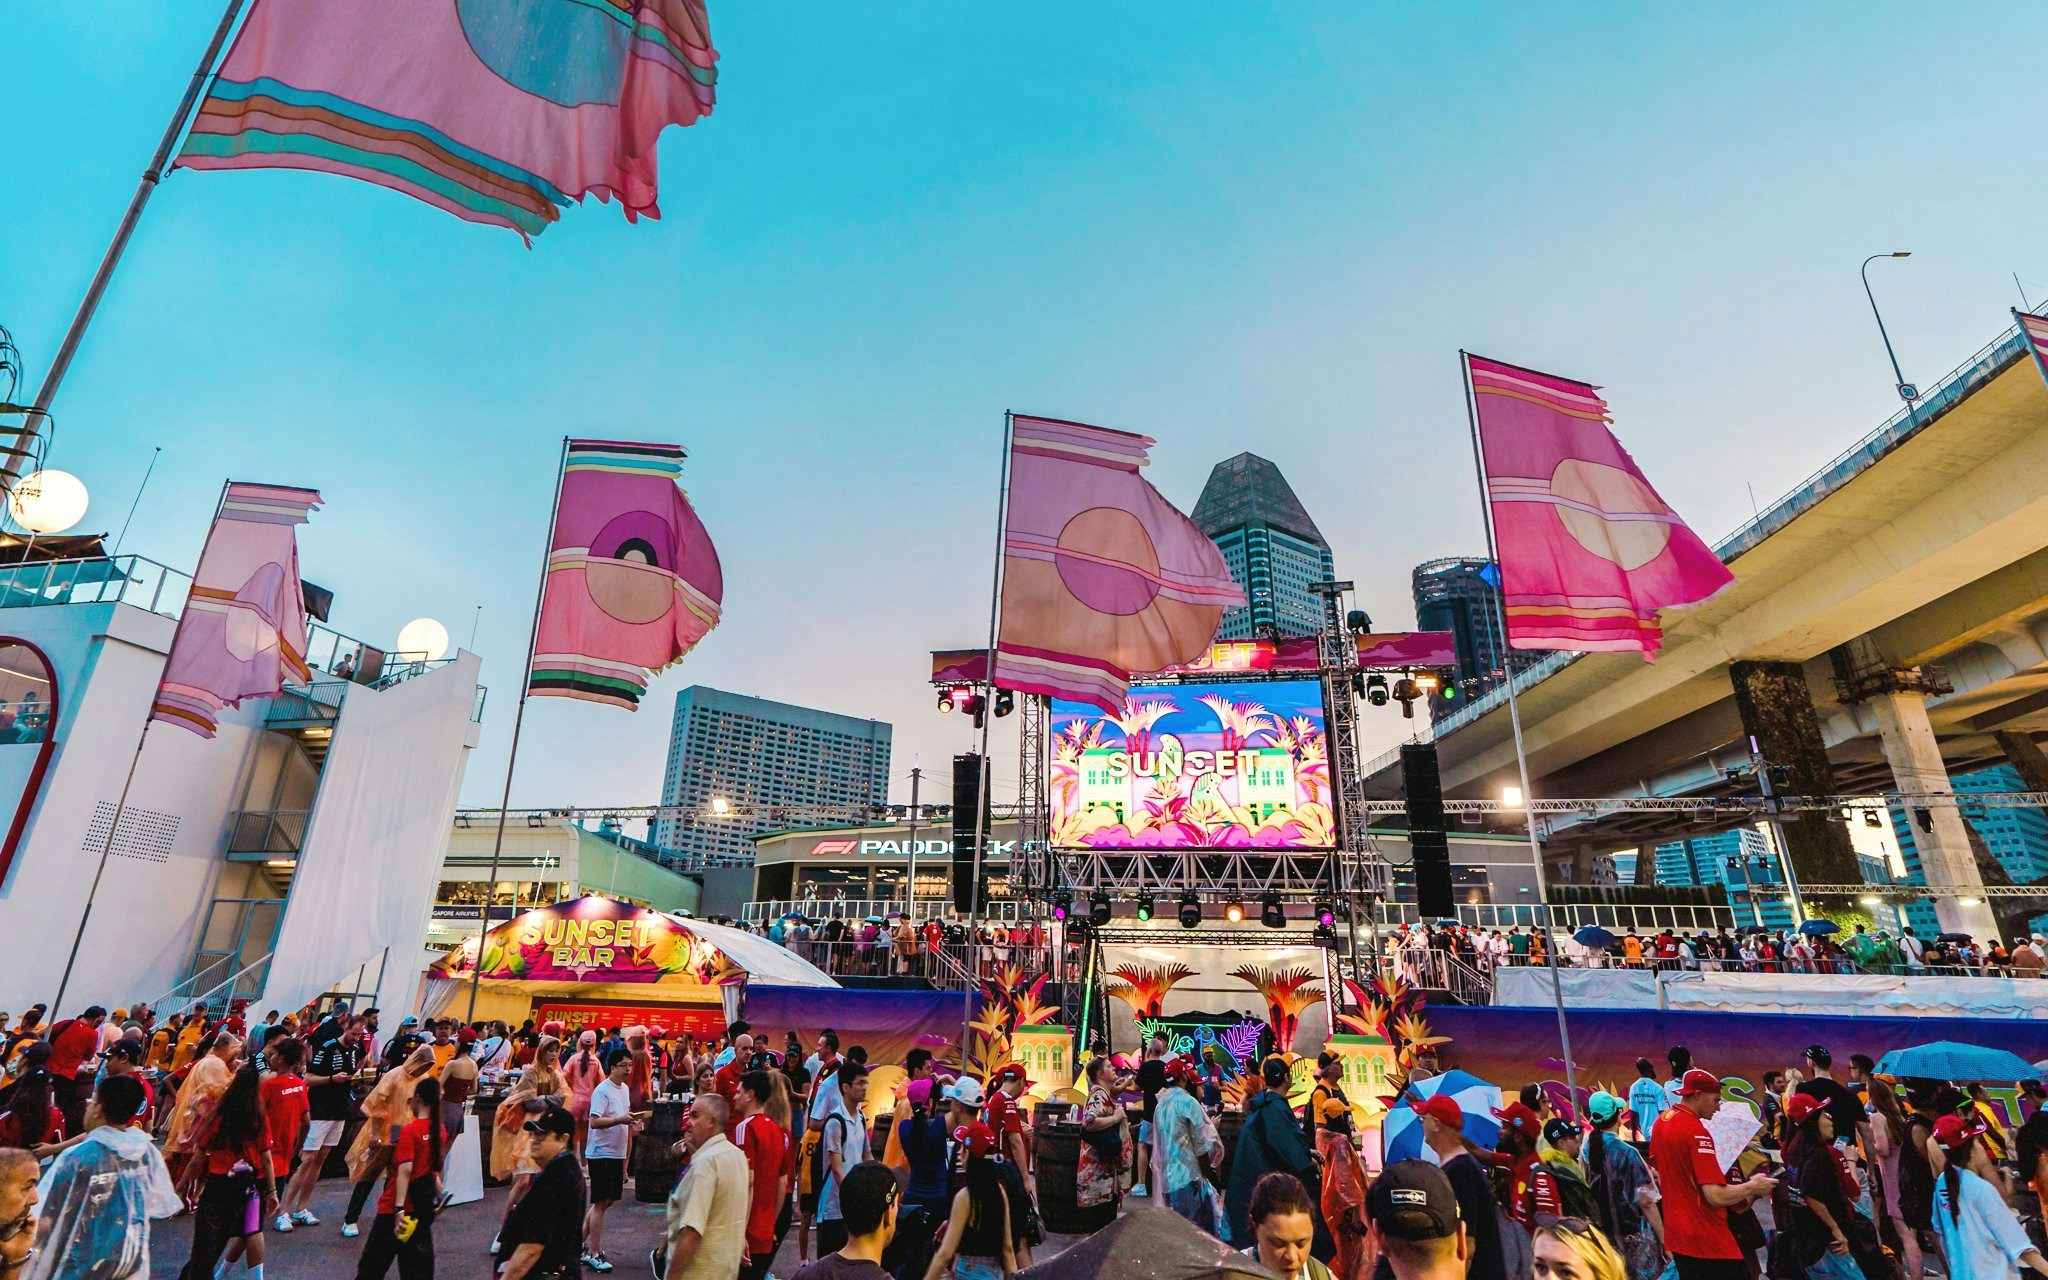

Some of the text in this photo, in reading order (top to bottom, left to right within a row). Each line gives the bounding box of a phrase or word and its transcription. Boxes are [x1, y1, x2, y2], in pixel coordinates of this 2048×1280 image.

[1108, 751, 1260, 777] SUNSET
[860, 840, 1018, 855] PADDK
[521, 919, 657, 947] SUNSET
[552, 947, 615, 967] BAR
[546, 1011, 599, 1024] SUNSET
